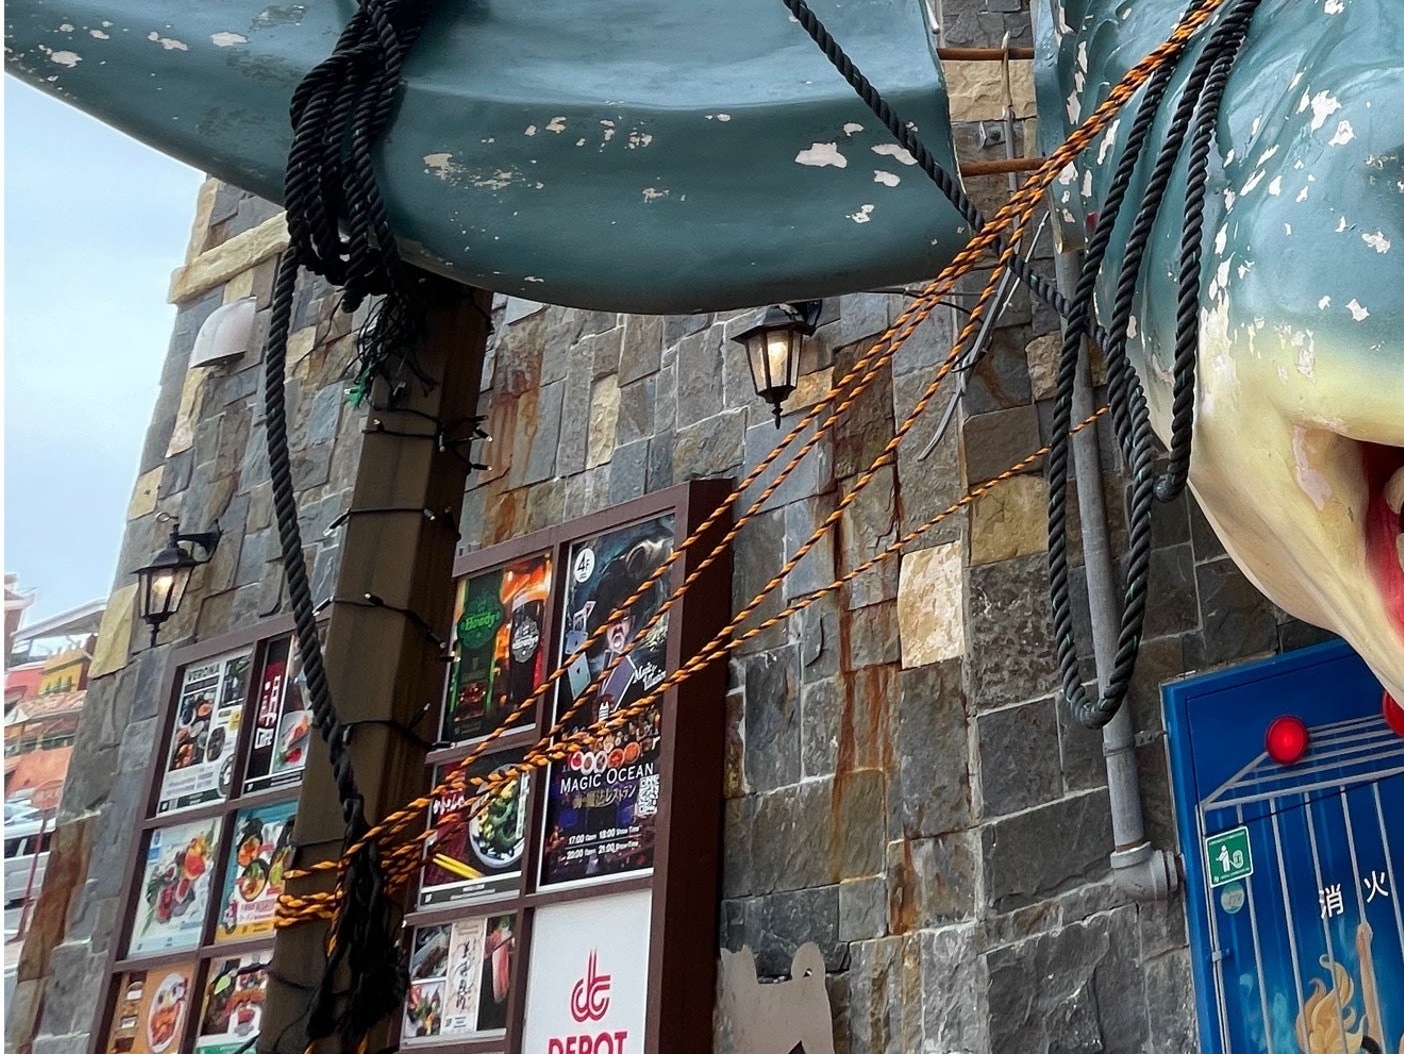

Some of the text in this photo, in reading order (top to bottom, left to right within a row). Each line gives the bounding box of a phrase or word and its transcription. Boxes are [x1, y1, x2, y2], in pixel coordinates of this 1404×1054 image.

[561, 763, 654, 794] MAGIC OCEAN
[548, 1031, 628, 1054] DEPOT
